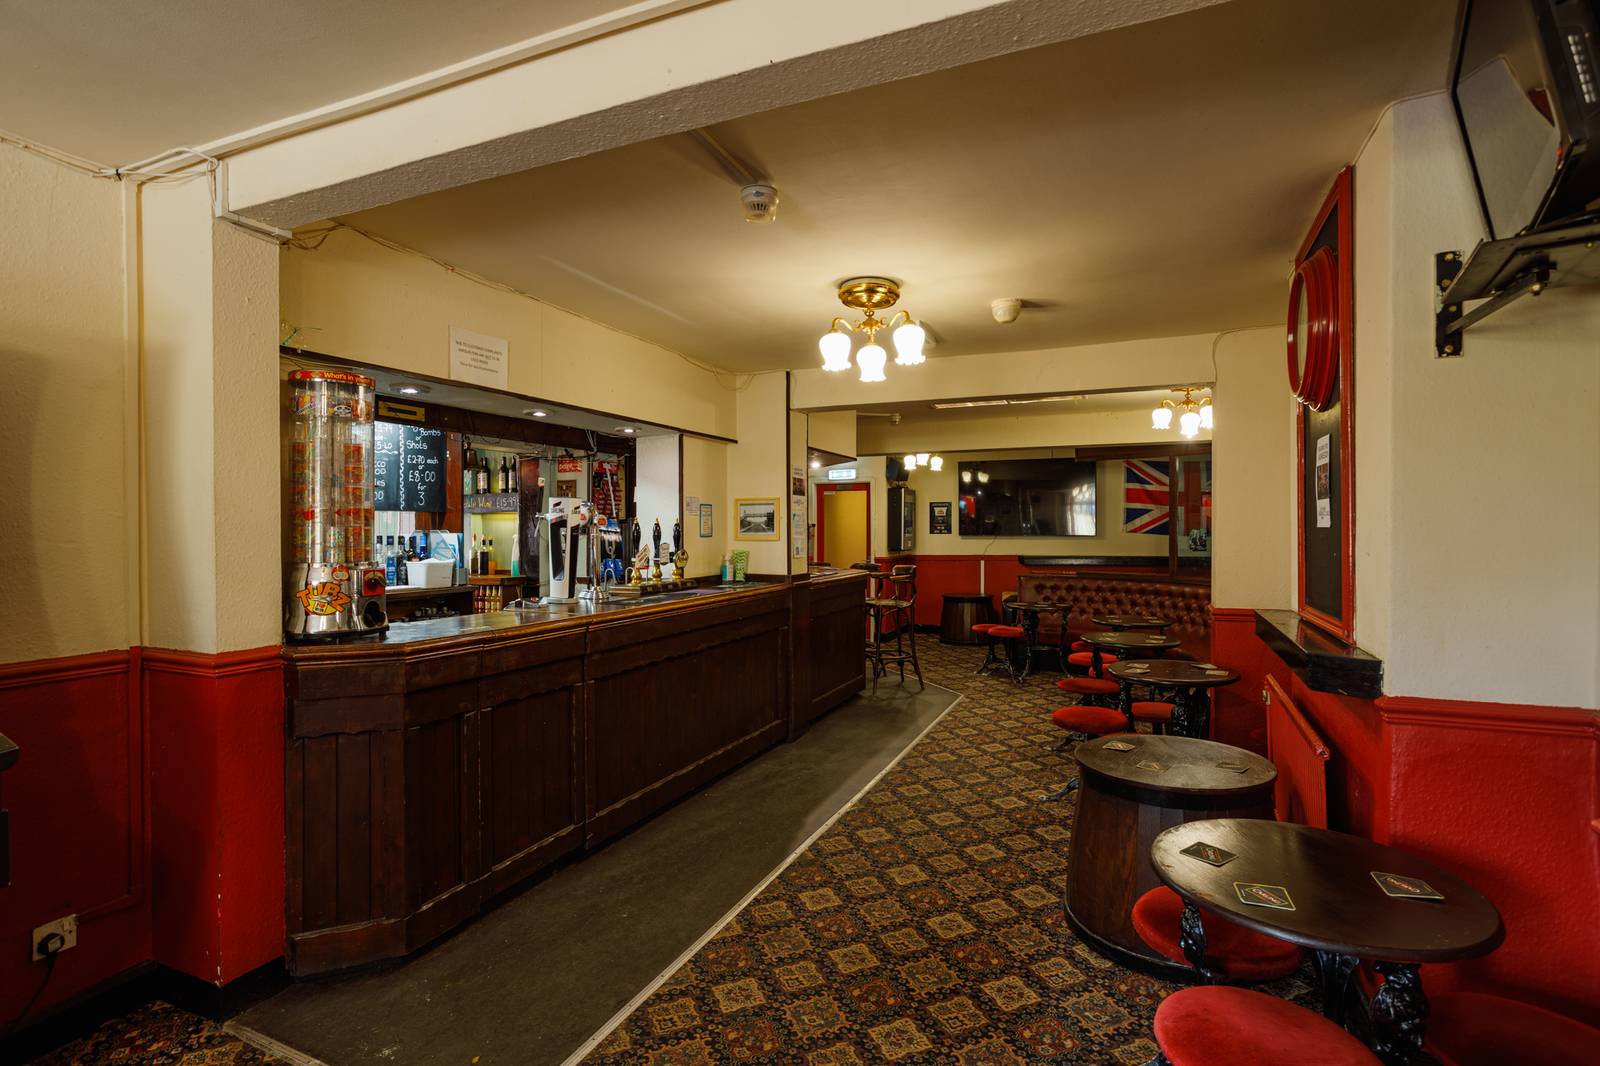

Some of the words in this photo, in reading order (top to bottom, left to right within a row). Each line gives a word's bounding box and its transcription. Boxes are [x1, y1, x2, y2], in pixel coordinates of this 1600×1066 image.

[323, 372, 347, 380] What's
[419, 428, 441, 437] Bombs
[406, 440, 428, 450] Shots
[426, 456, 439, 465] each
[417, 491, 425, 506] 3
[296, 581, 352, 613] TUBZ
